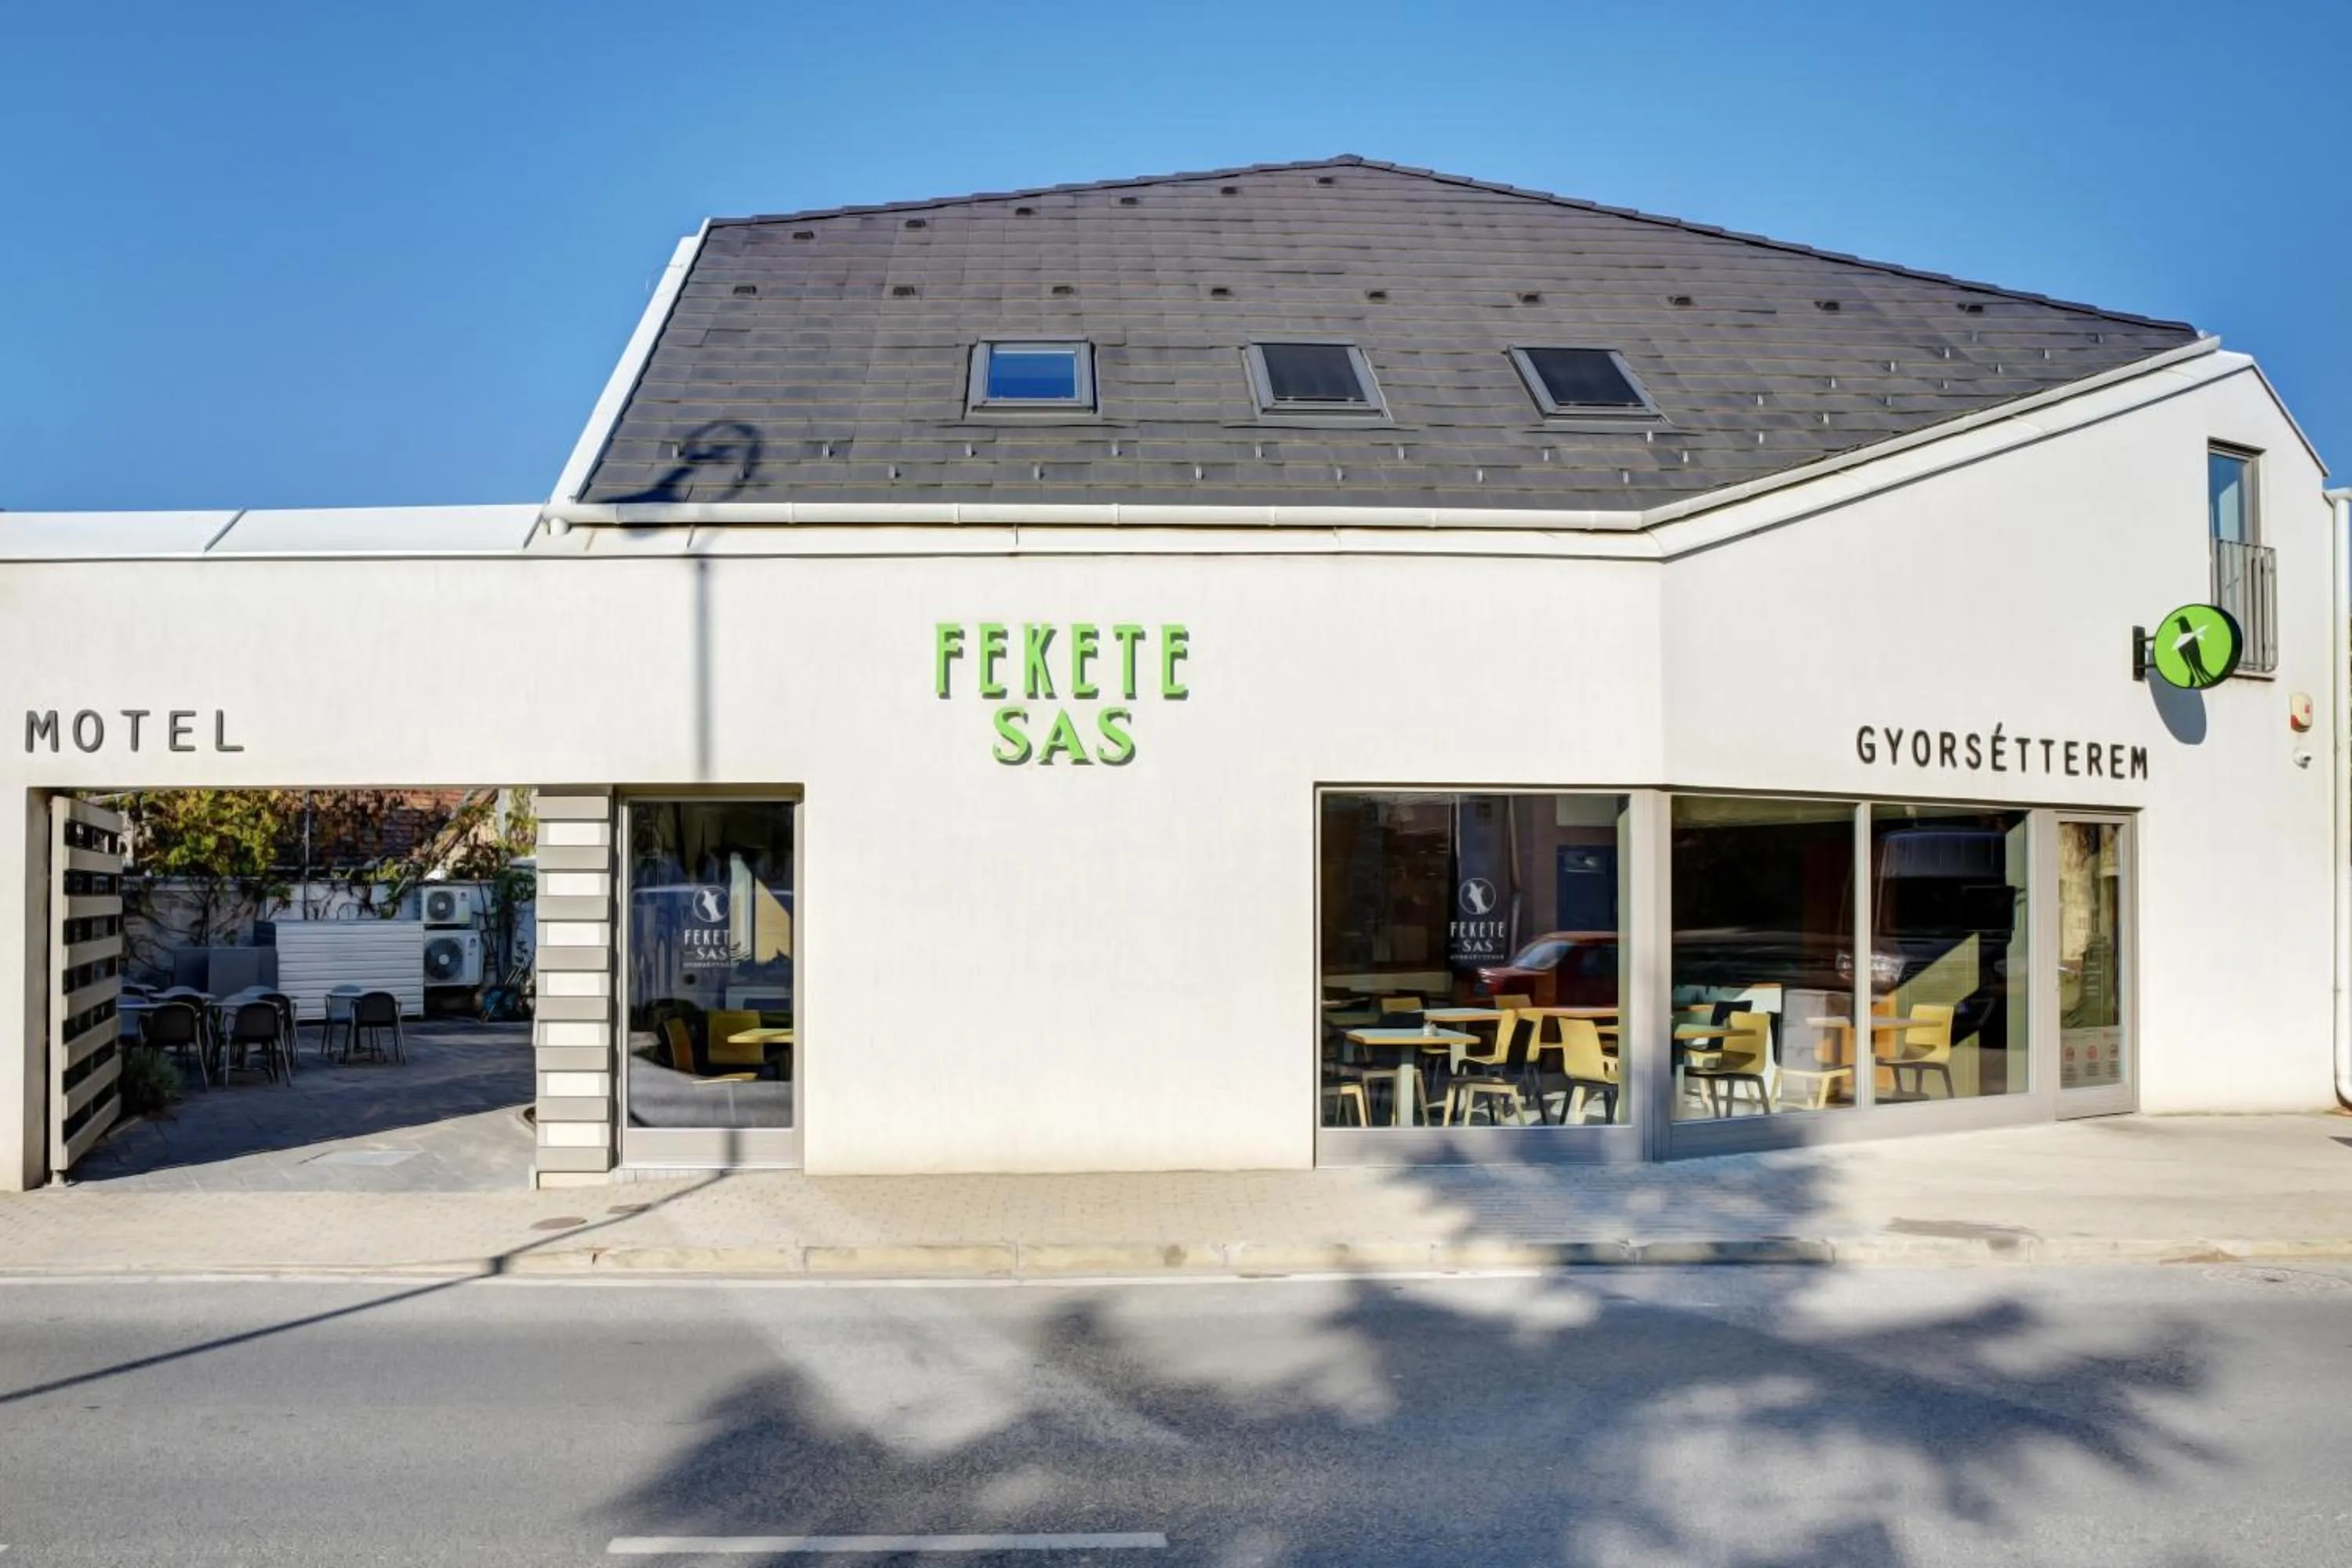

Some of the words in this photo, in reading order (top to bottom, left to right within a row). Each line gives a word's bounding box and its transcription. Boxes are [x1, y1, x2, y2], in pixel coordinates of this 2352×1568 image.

[936, 623, 1189, 699] FEKETE
[25, 709, 244, 753] MOTEL
[993, 707, 1137, 766] SAS
[1857, 722, 2148, 780] GYORSÉTTEREM
[684, 929, 729, 946] FEKET
[1450, 921, 1505, 938] FEKETE
[697, 947, 728, 960] SAS
[1462, 940, 1494, 953] SAS
